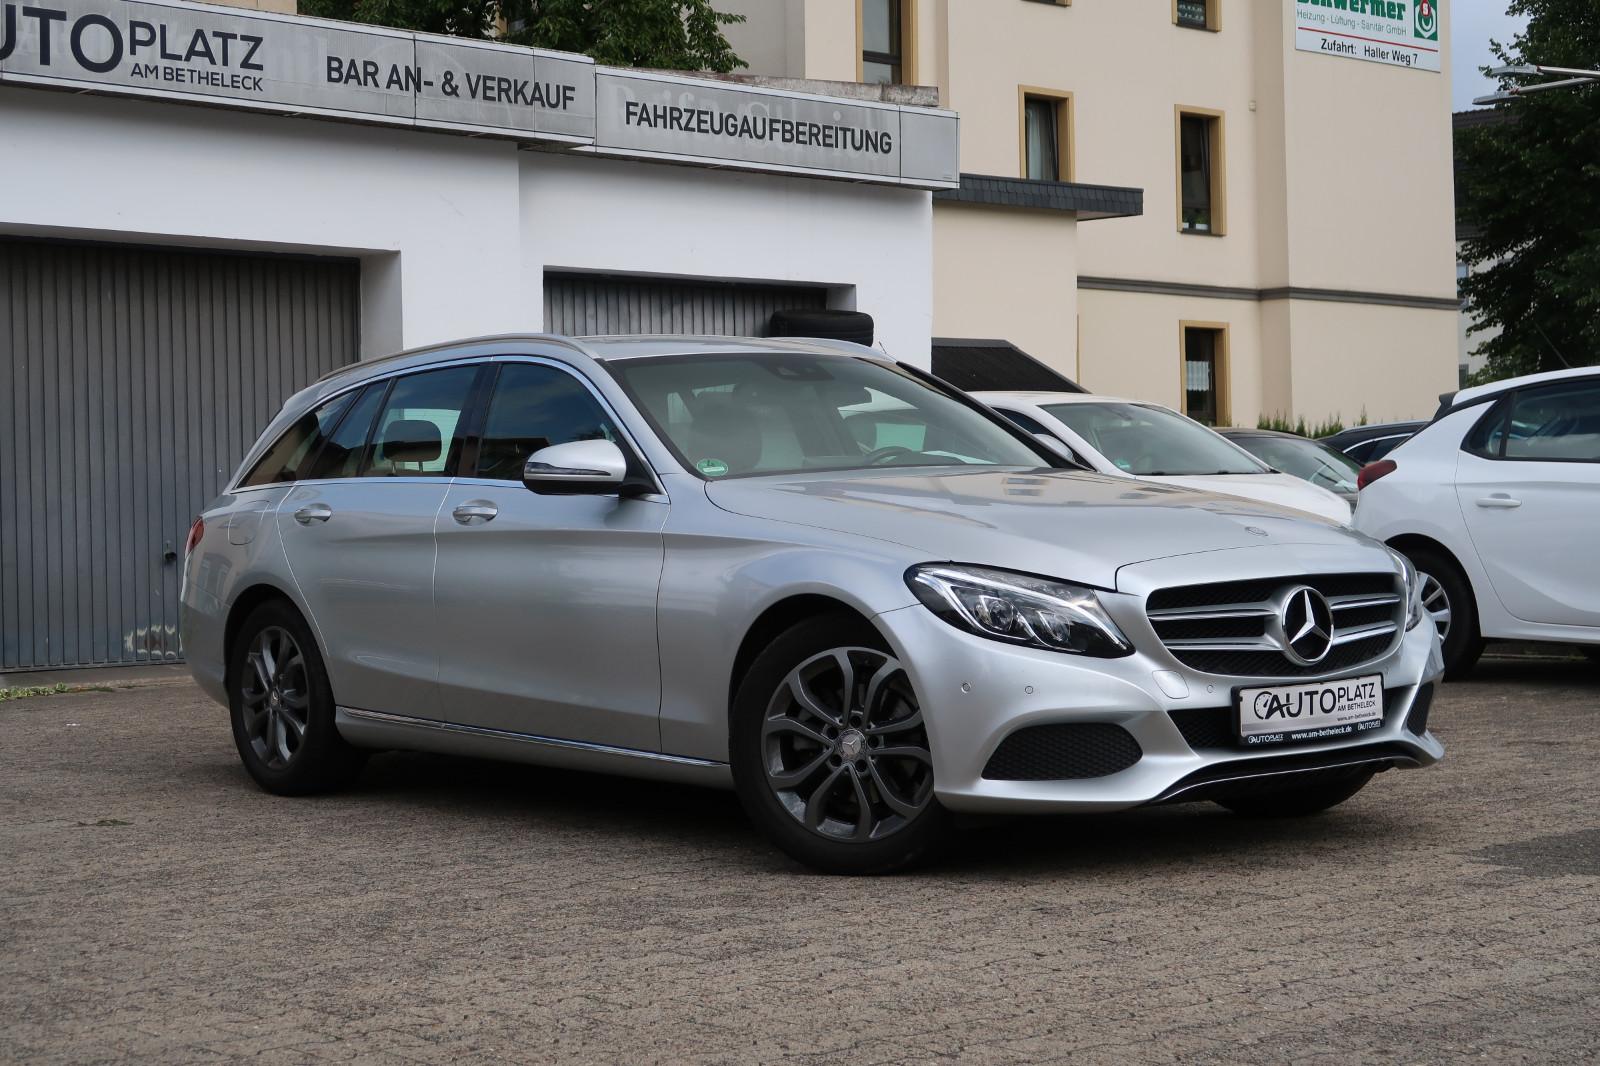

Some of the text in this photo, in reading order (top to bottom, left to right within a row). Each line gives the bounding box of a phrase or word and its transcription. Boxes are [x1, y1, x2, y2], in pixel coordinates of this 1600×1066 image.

[1297, 0, 1405, 20] wermer
[1297, 9, 1325, 24] Heizung
[1331, 15, 1355, 30] Lüftung
[1386, 24, 1407, 36] GmbH
[1321, 38, 1418, 66] Zufahrt: Haller Weg 7
[130, 62, 264, 92] AM BETHELECK
[326, 55, 576, 111] BAR AN- & VERKAUF
[624, 100, 893, 155] FAHRZEUGAUFBEREITUNG
[1338, 700, 1376, 712] AM BETHELECK
[1291, 725, 1352, 740] www.am-betheleck.de
